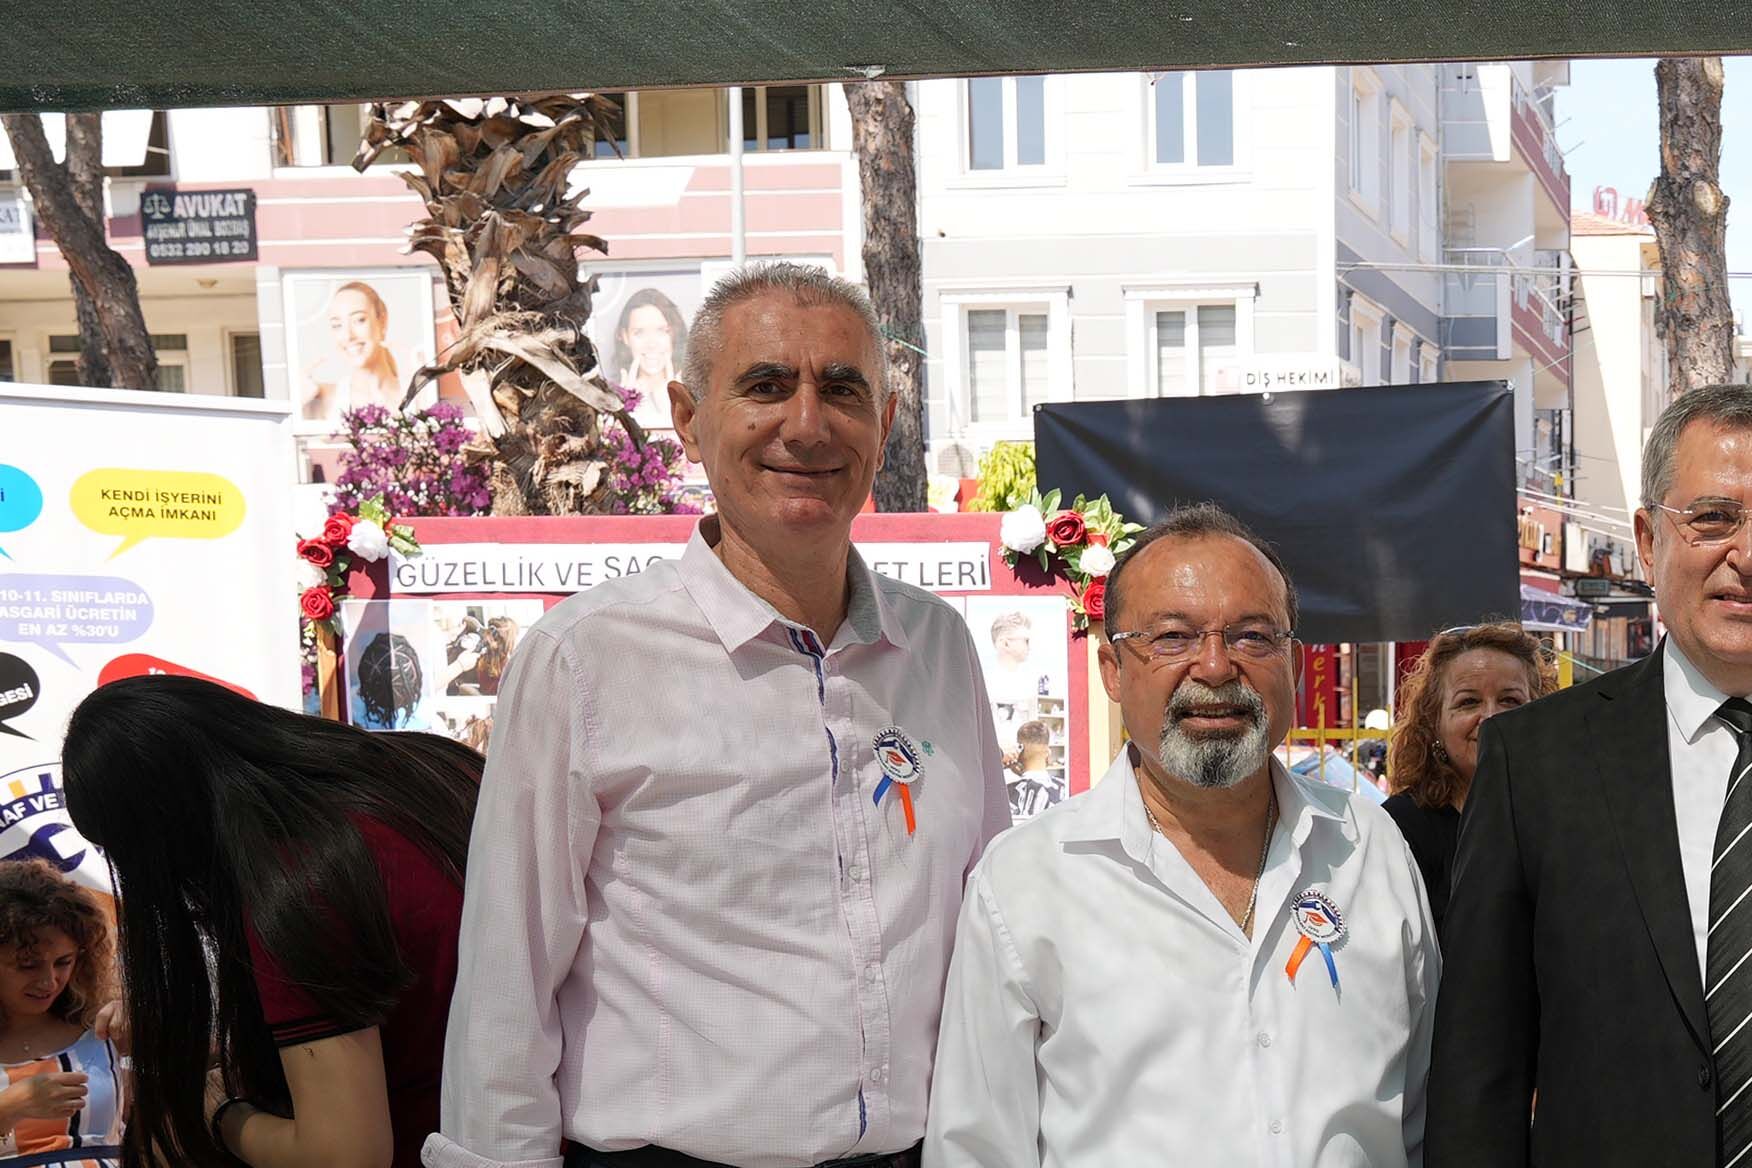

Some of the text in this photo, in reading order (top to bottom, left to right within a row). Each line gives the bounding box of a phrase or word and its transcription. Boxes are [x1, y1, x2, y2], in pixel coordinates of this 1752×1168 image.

[173, 193, 247, 218] AVUKAT
[101, 488, 222, 505] KENDİ İŞYERİNİ
[109, 505, 217, 521] AÇMA İMKANI
[397, 556, 544, 587] GÜZELLİK
[555, 562, 593, 586] VE
[51, 590, 150, 605] SINIFLARDA
[0, 604, 137, 621] ASGARİ ÜCRETİN
[18, 623, 41, 636] EN
[46, 624, 67, 636] AZ
[29, 793, 59, 812] VE
